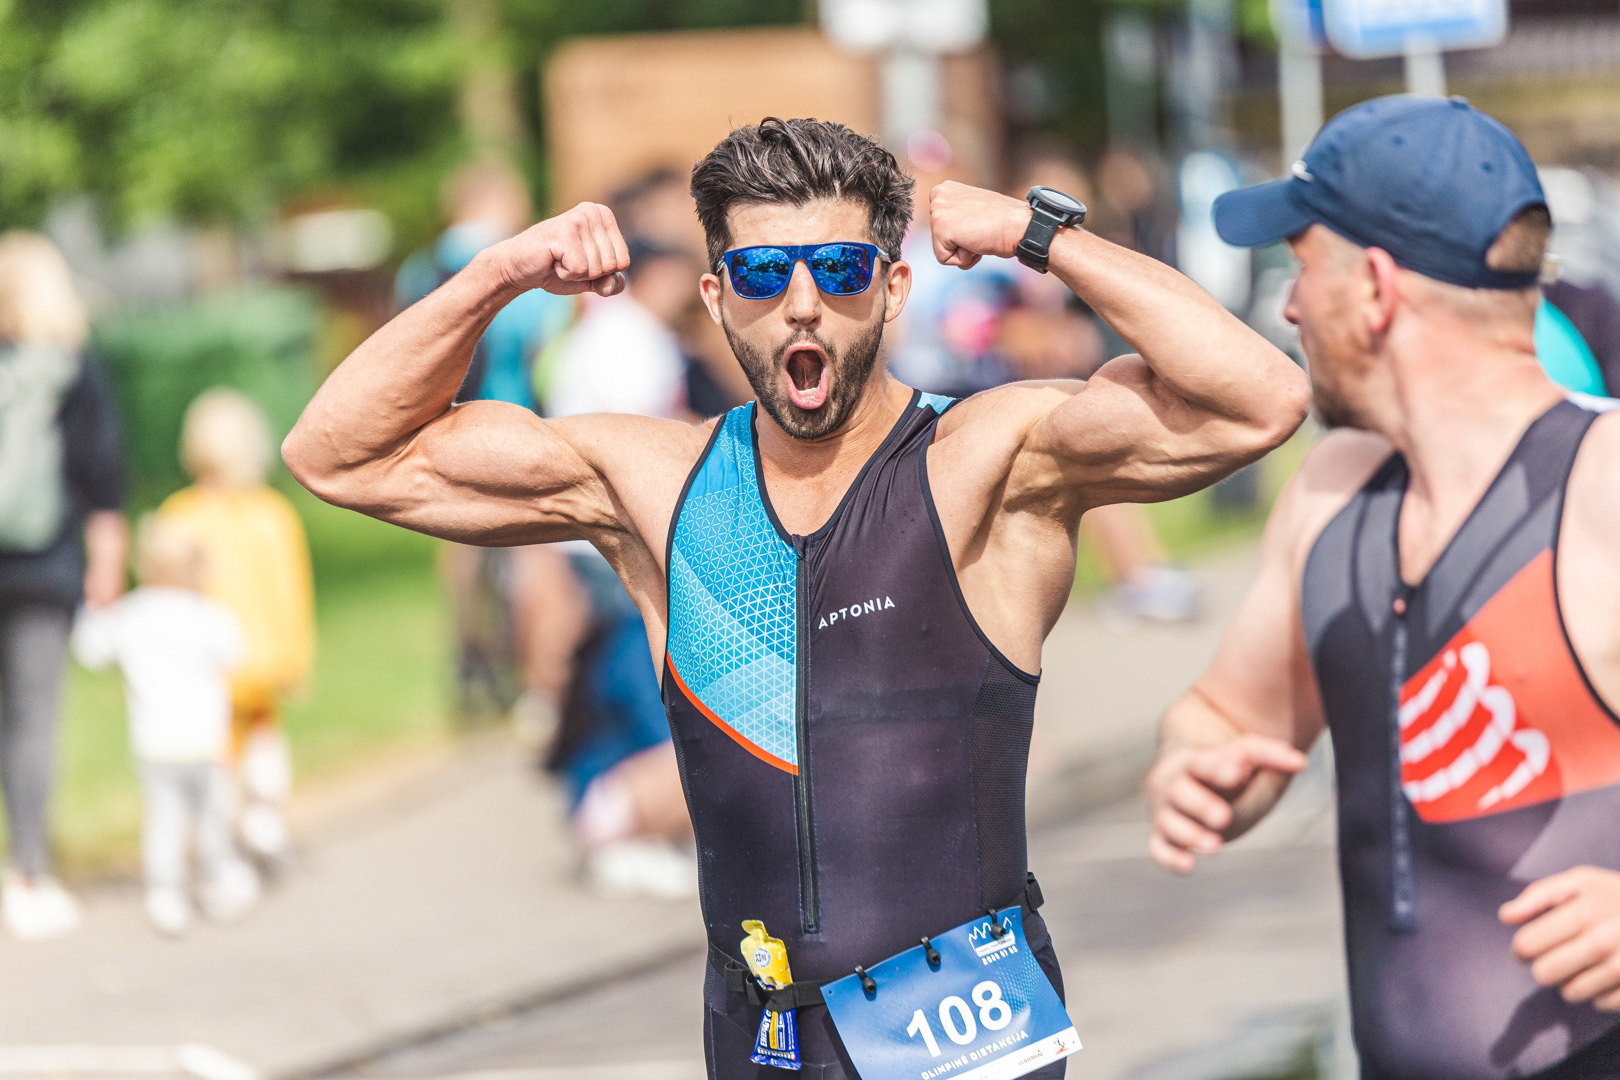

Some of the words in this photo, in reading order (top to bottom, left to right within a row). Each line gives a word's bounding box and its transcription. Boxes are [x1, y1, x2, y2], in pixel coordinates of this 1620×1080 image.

[818, 595, 896, 630] APTONIA
[906, 980, 1013, 1059] 108
[920, 1055, 970, 1080] OLIMPINĖ
[969, 1030, 1029, 1061] DISTANCIJA
